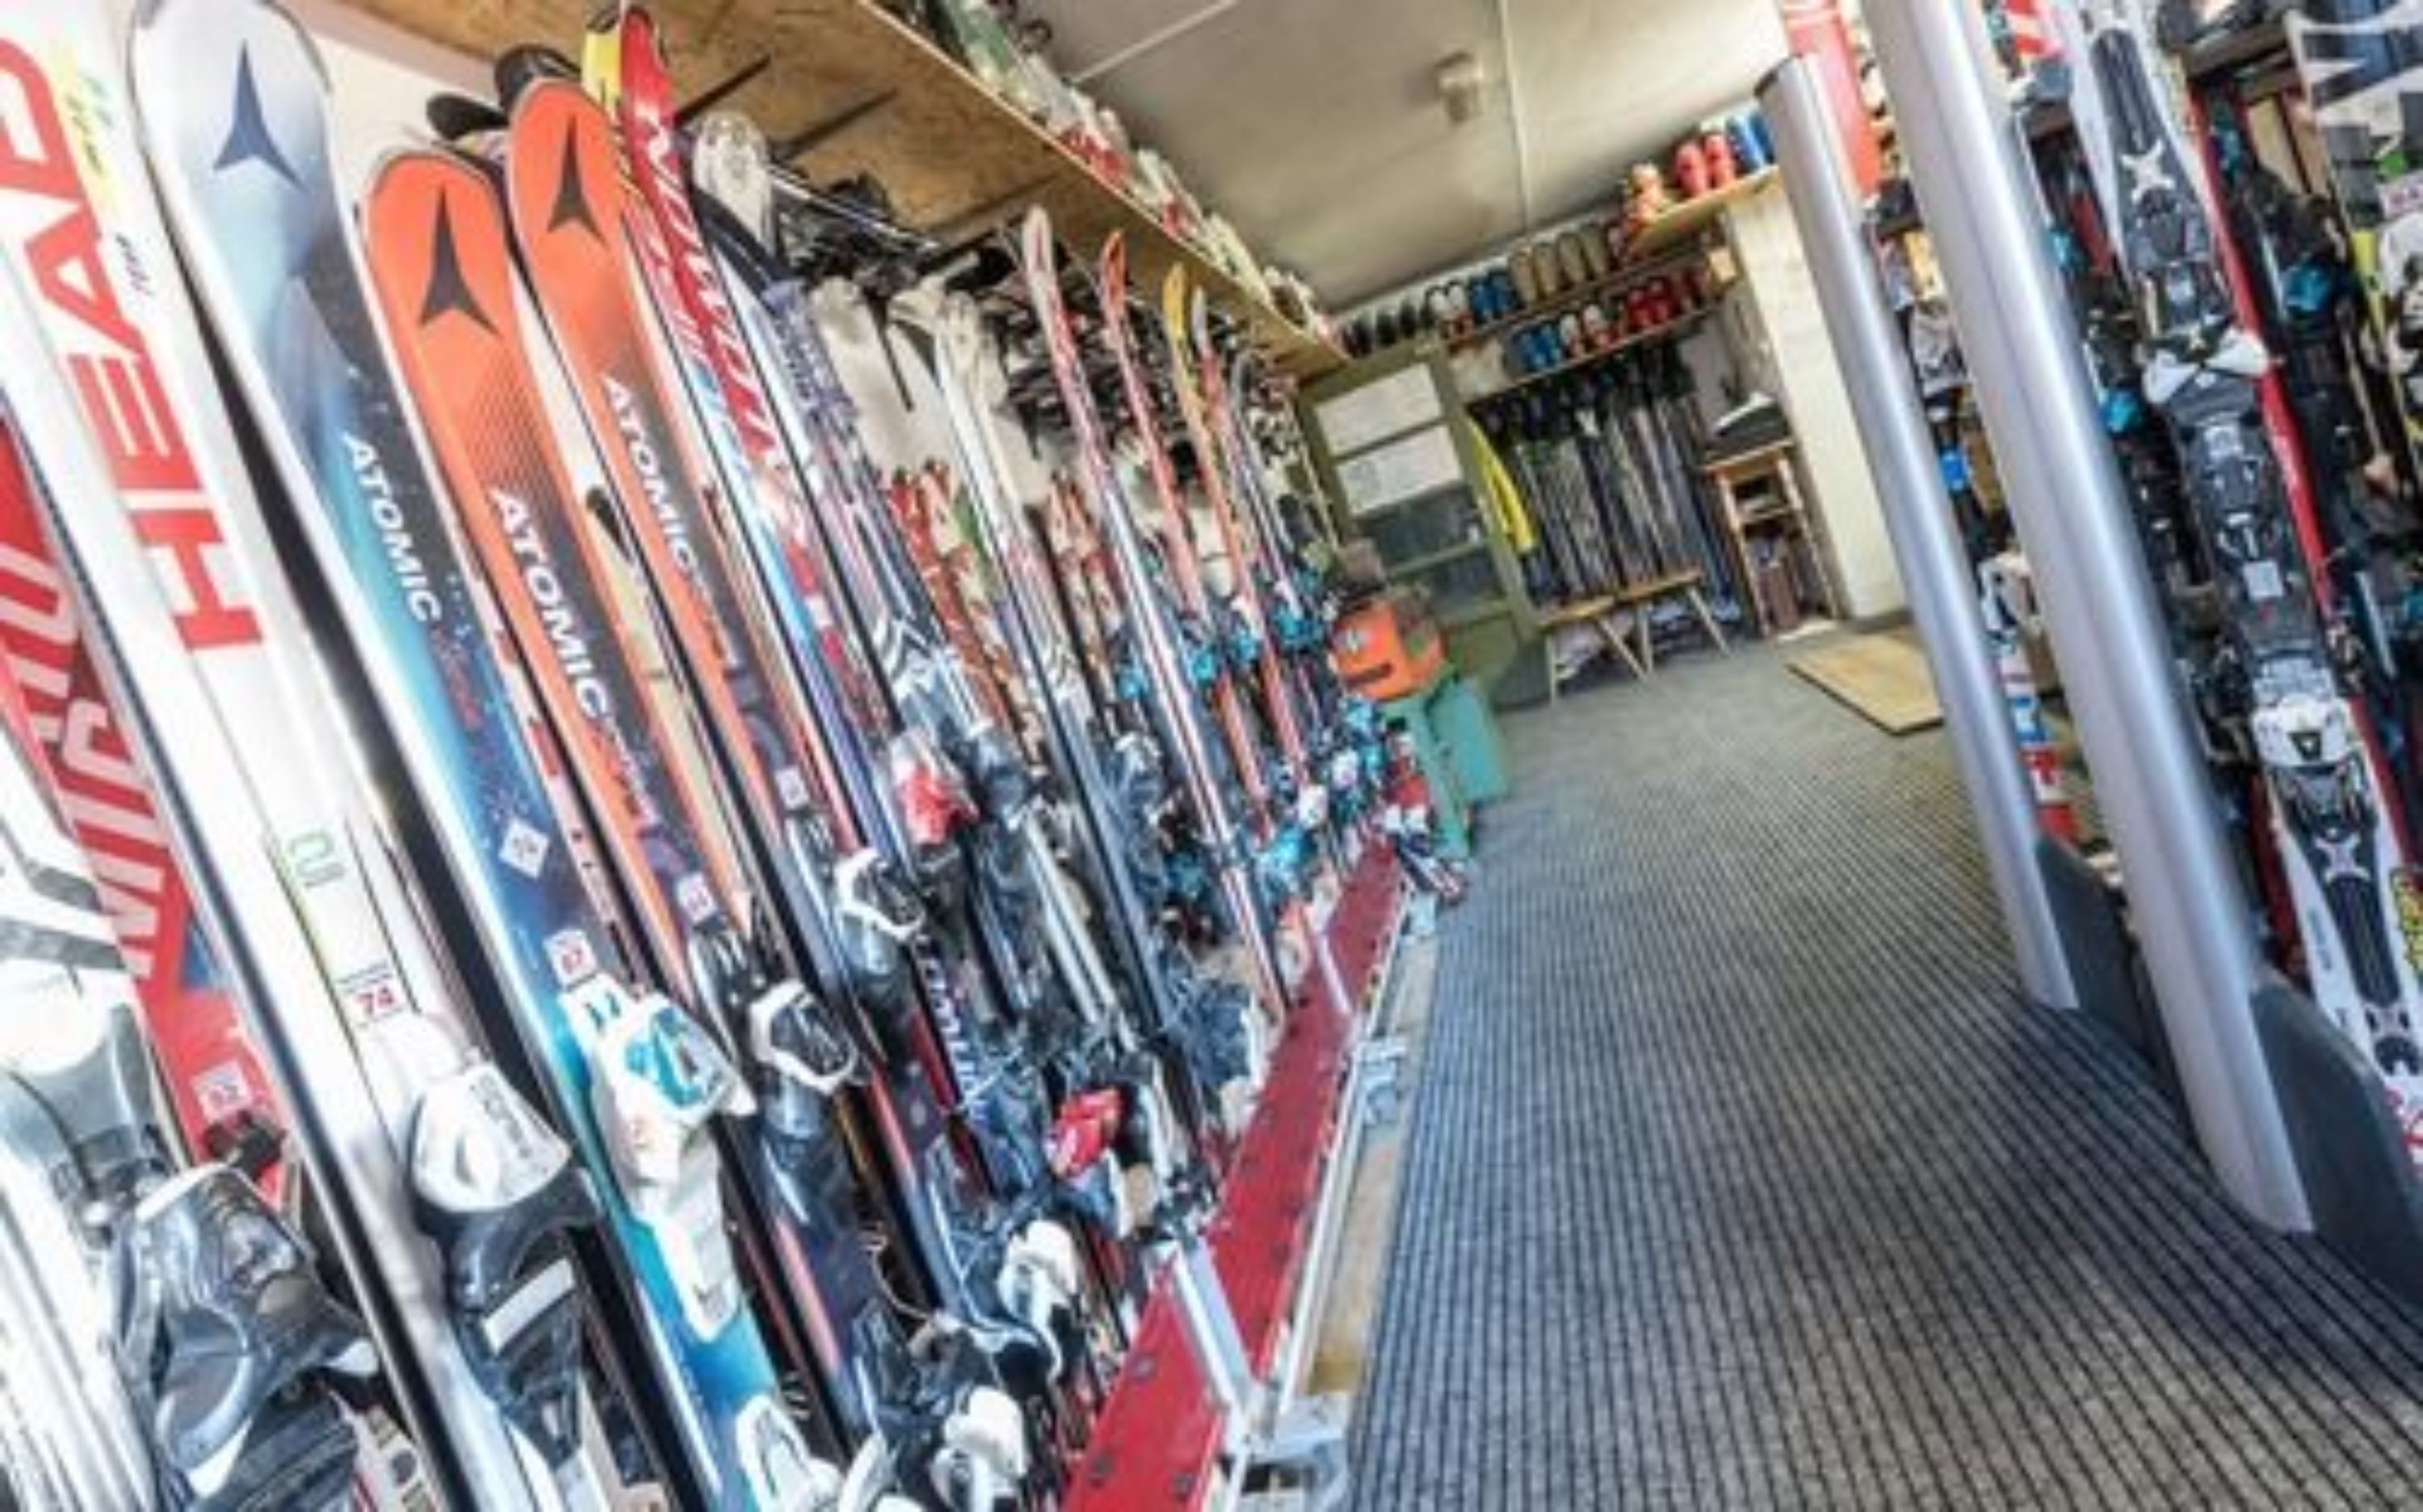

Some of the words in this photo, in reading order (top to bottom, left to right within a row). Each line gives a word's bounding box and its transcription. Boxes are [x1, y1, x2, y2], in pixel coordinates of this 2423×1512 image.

[0, 36, 262, 653] HEAD
[342, 430, 443, 624] ATOMIC
[603, 374, 698, 569] ATOMIC
[489, 487, 609, 719] ATOMIC
[355, 987, 396, 1015] 74
